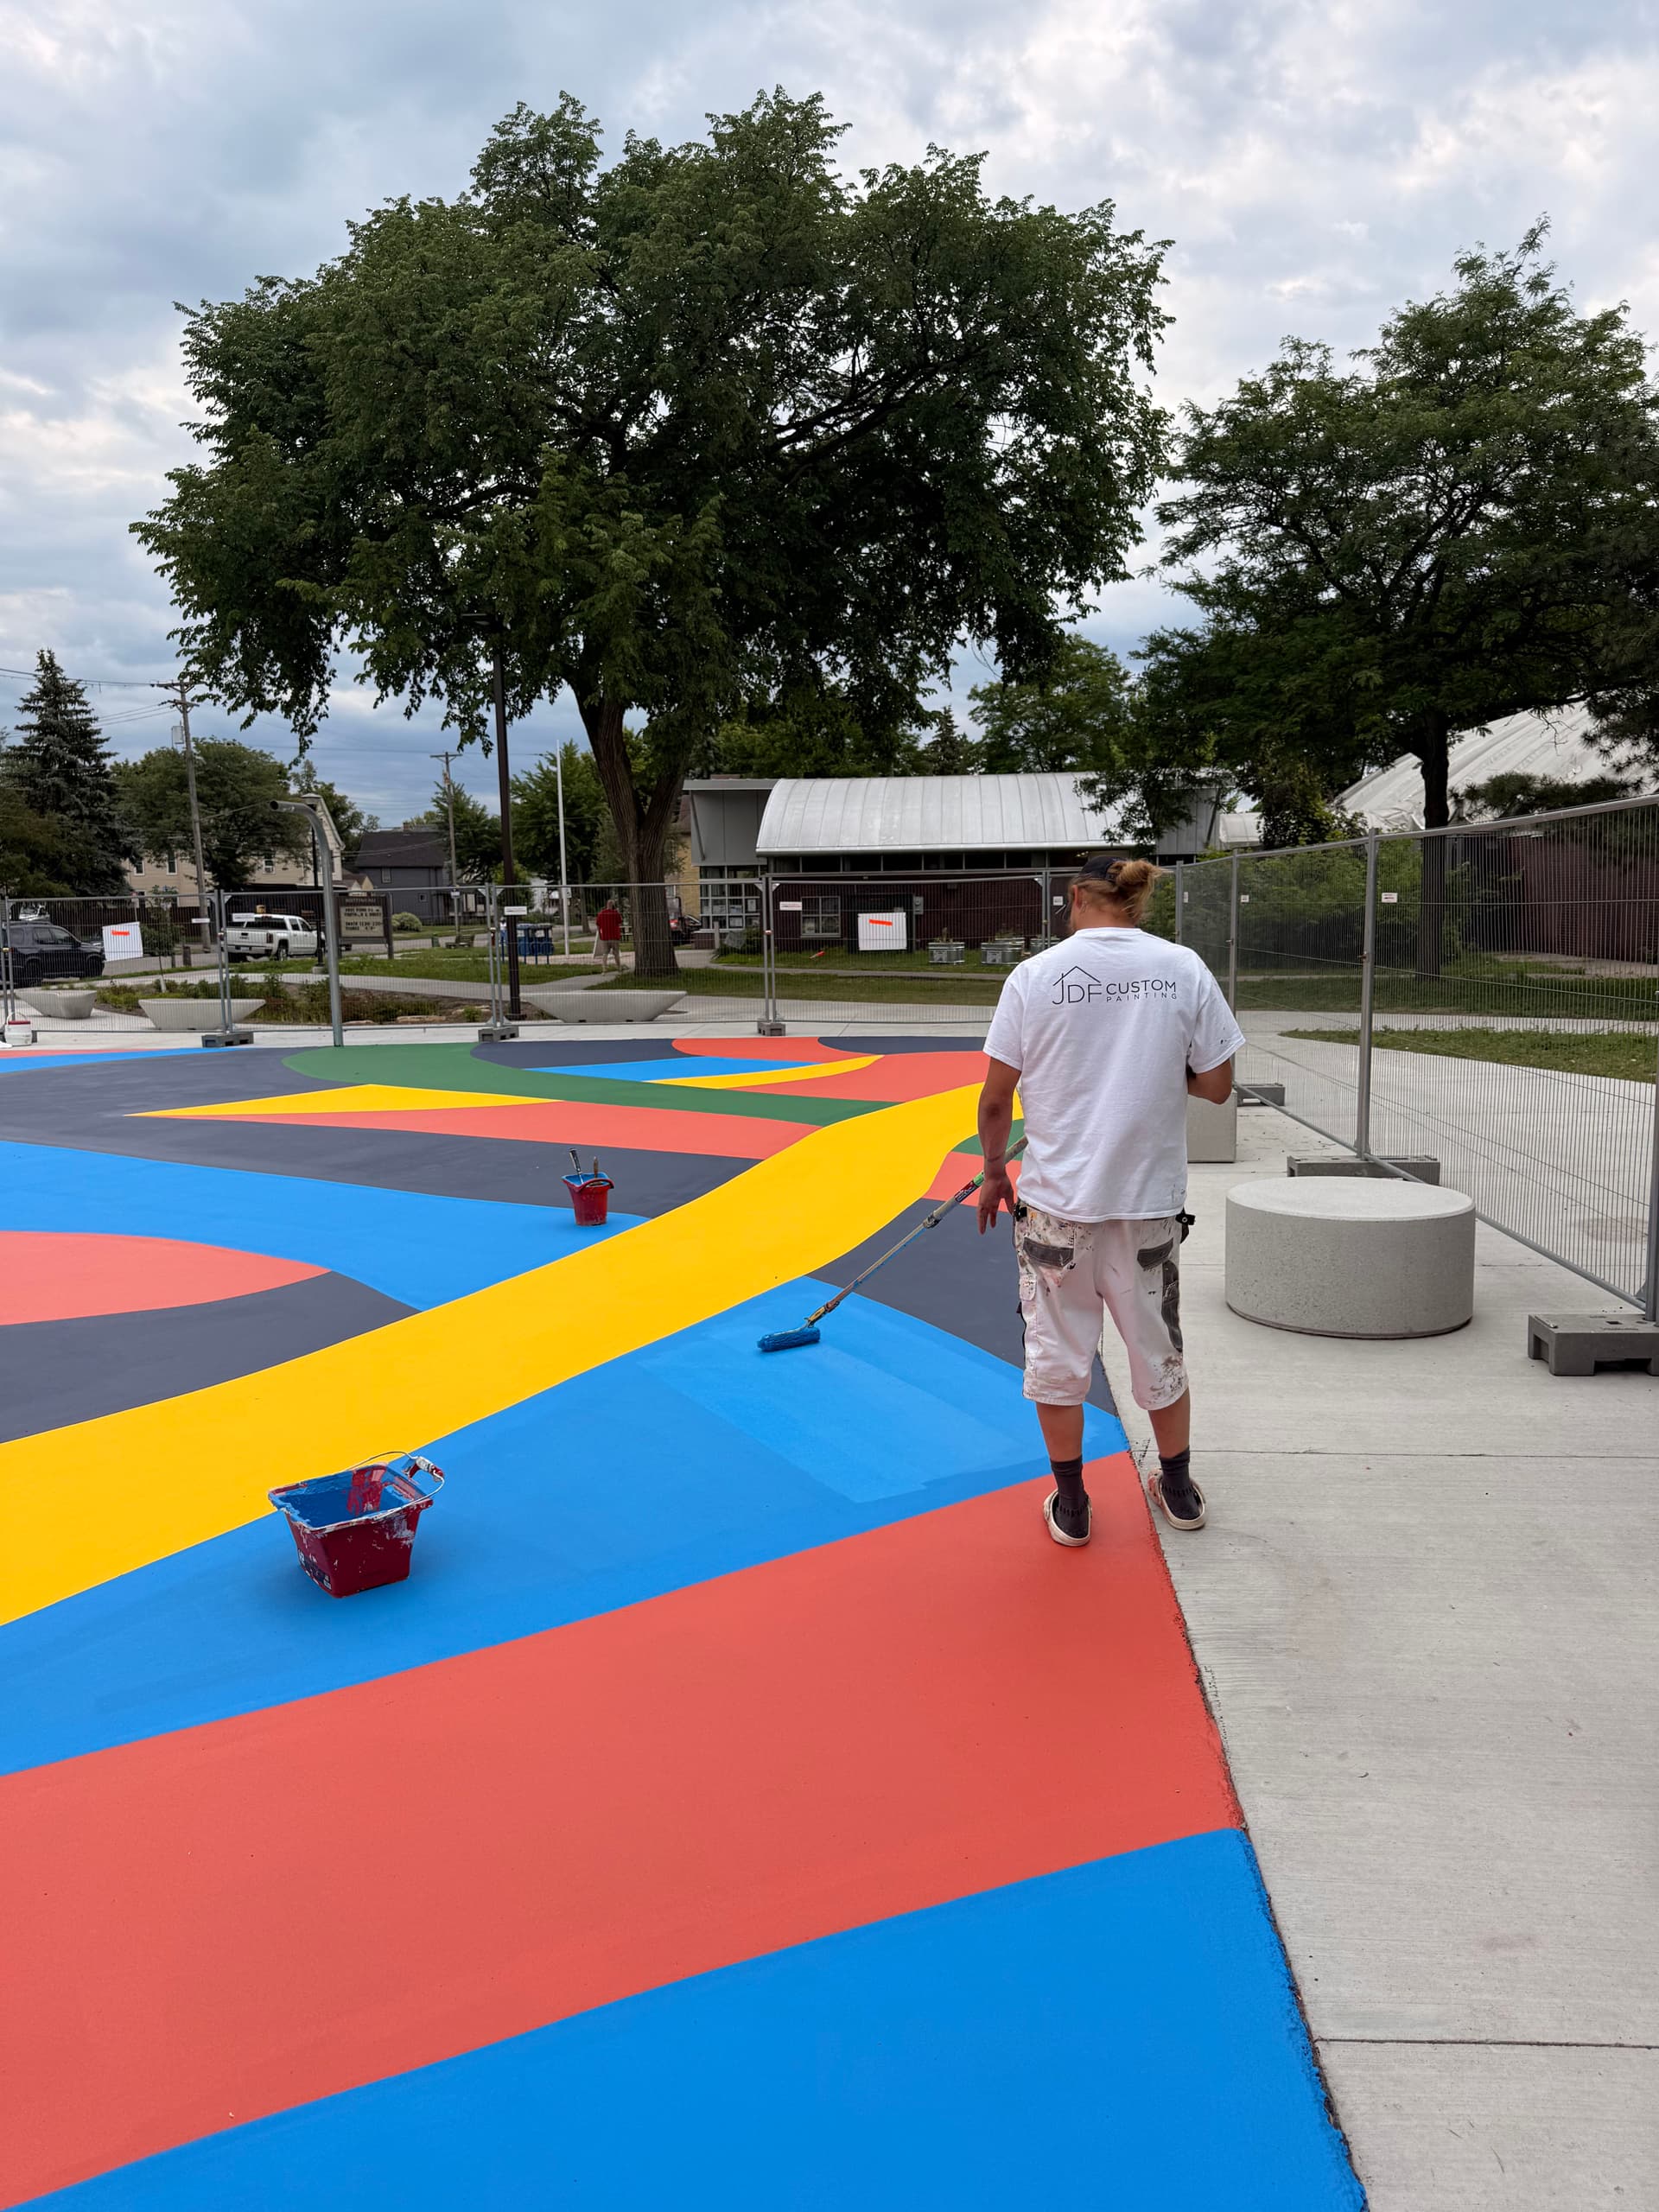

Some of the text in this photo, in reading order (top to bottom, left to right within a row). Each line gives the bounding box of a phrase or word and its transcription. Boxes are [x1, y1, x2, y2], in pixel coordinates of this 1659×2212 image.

[1052, 973, 1176, 1005] JDF CUSTOM
[1106, 992, 1177, 1002] PAINTING
